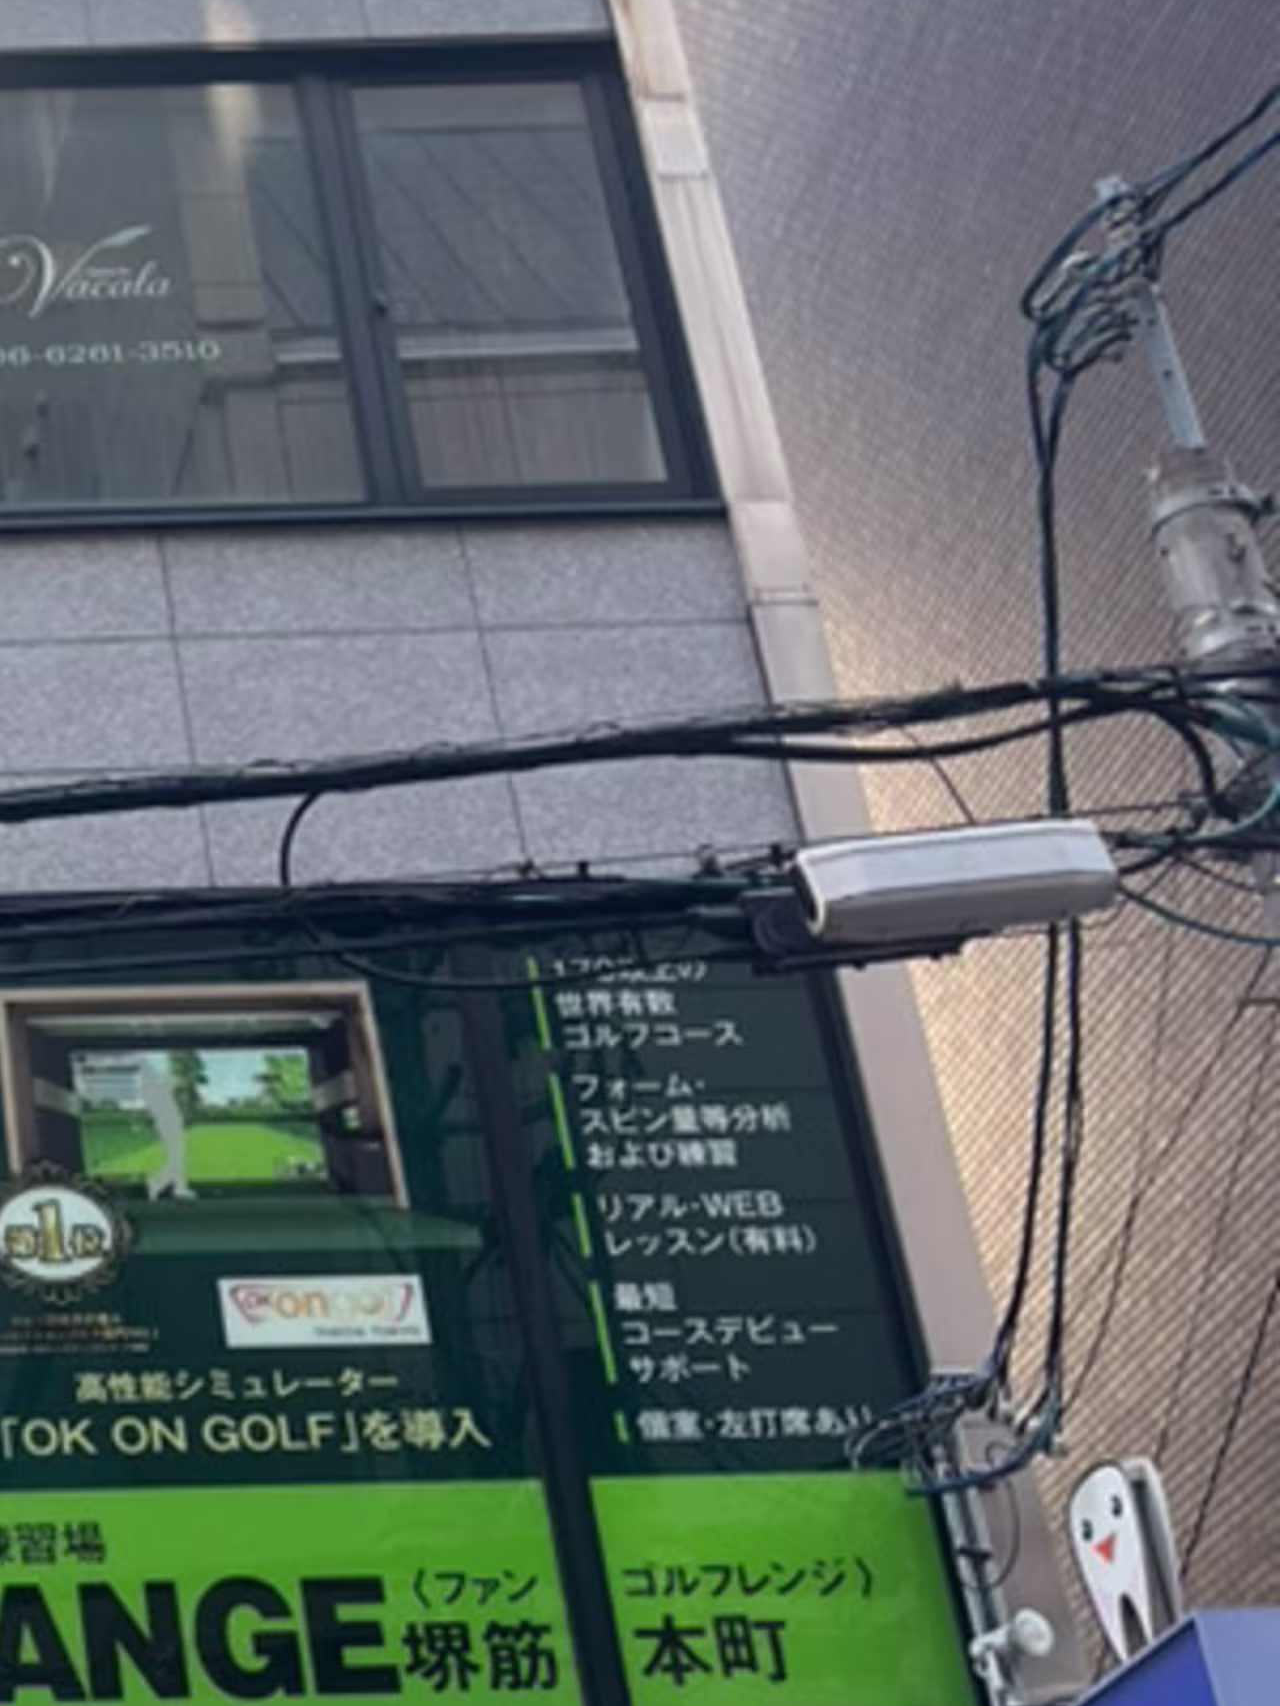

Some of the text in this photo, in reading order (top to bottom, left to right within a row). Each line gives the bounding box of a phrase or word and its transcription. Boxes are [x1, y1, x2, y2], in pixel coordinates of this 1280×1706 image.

[563, 1020, 743, 1050] ゴルフコース
[622, 1316, 841, 1347] コースデビュー
[630, 1352, 751, 1383] サポート
[75, 1367, 398, 1404] 高性能シミュレーター
[112, 1414, 189, 1455] ON
